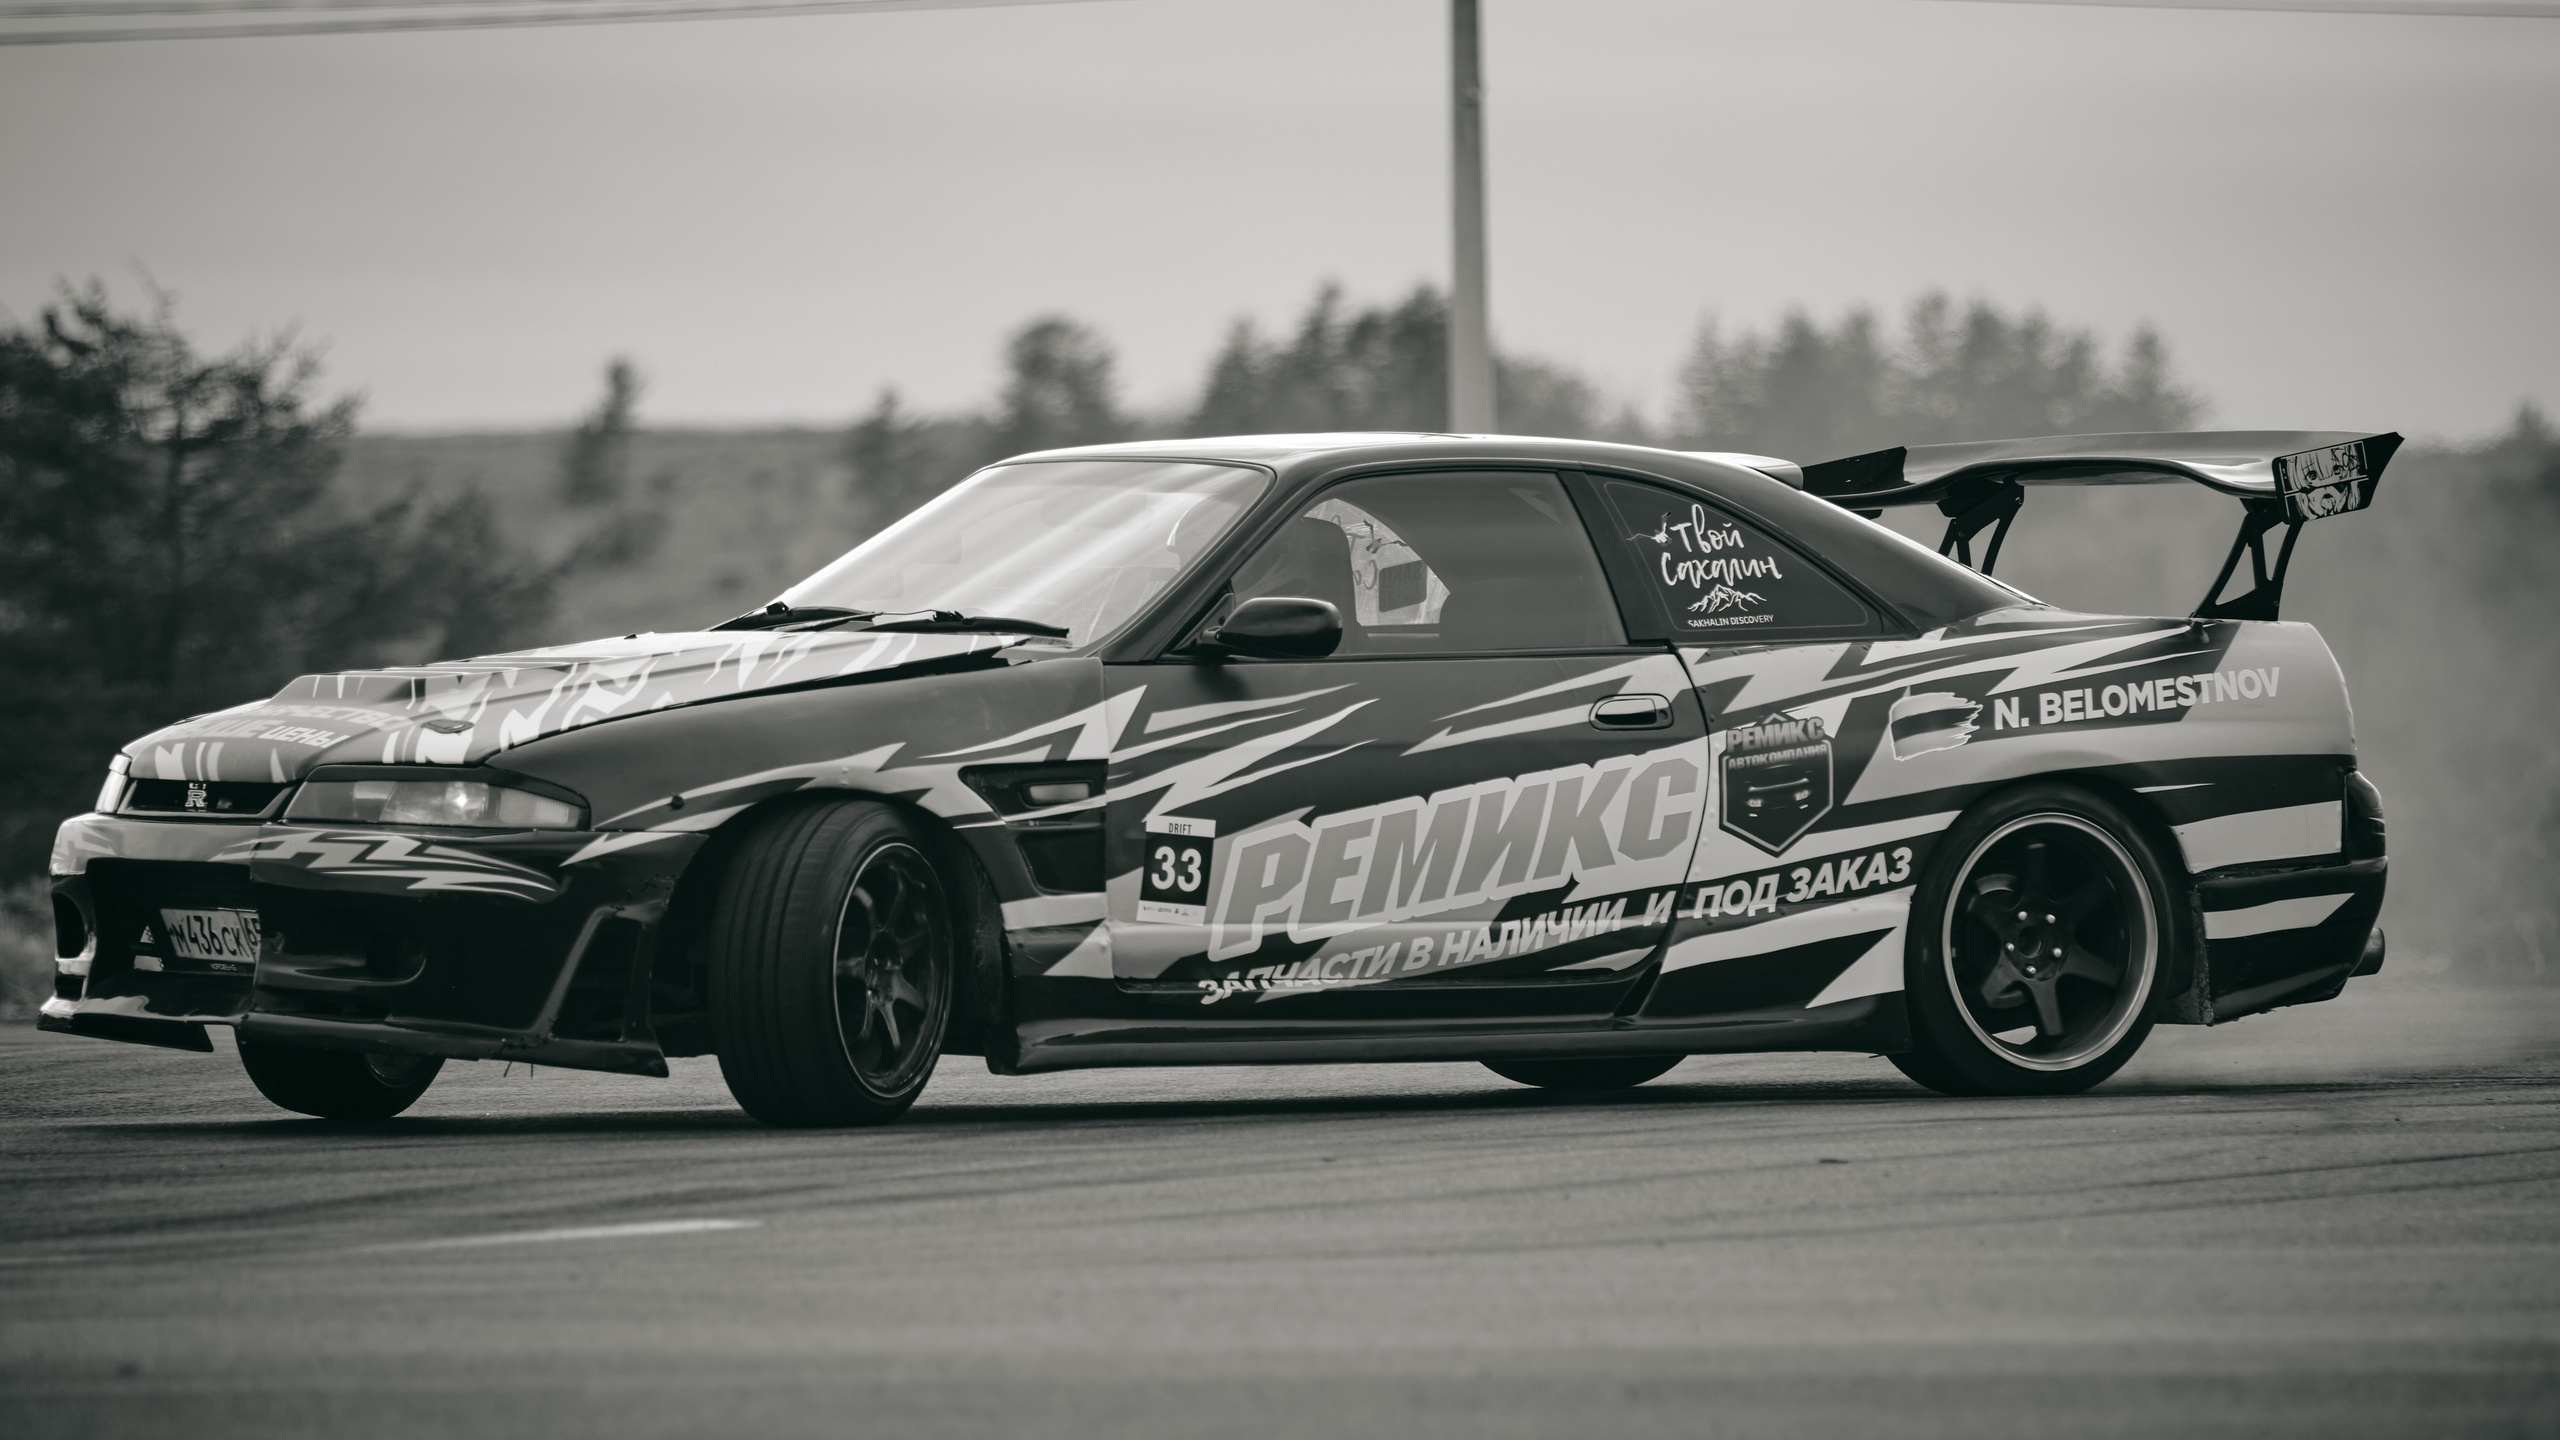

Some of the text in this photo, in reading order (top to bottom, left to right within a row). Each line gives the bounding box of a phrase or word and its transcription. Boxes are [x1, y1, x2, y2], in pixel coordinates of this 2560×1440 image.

[1669, 503, 1745, 553] Твой
[1661, 552, 1783, 589] Сахалин
[1687, 614, 1774, 628] SAKHALIN DISCOVERY
[1994, 667, 2280, 731] N. BELOMESTNOV
[258, 725, 351, 749] ЦЕНЫ
[1727, 717, 1826, 753] РЕМИКС
[1728, 744, 1828, 770] АВТОКОМПАНИЯ
[1168, 823, 1192, 835] DRIFT
[1151, 846, 1202, 892] 33
[1208, 752, 1703, 961] РЕМИКС
[1197, 846, 1913, 1006] ЗАПЧАСТИ В НАЛИЧИИ И ПОД ЗАКАЗ
